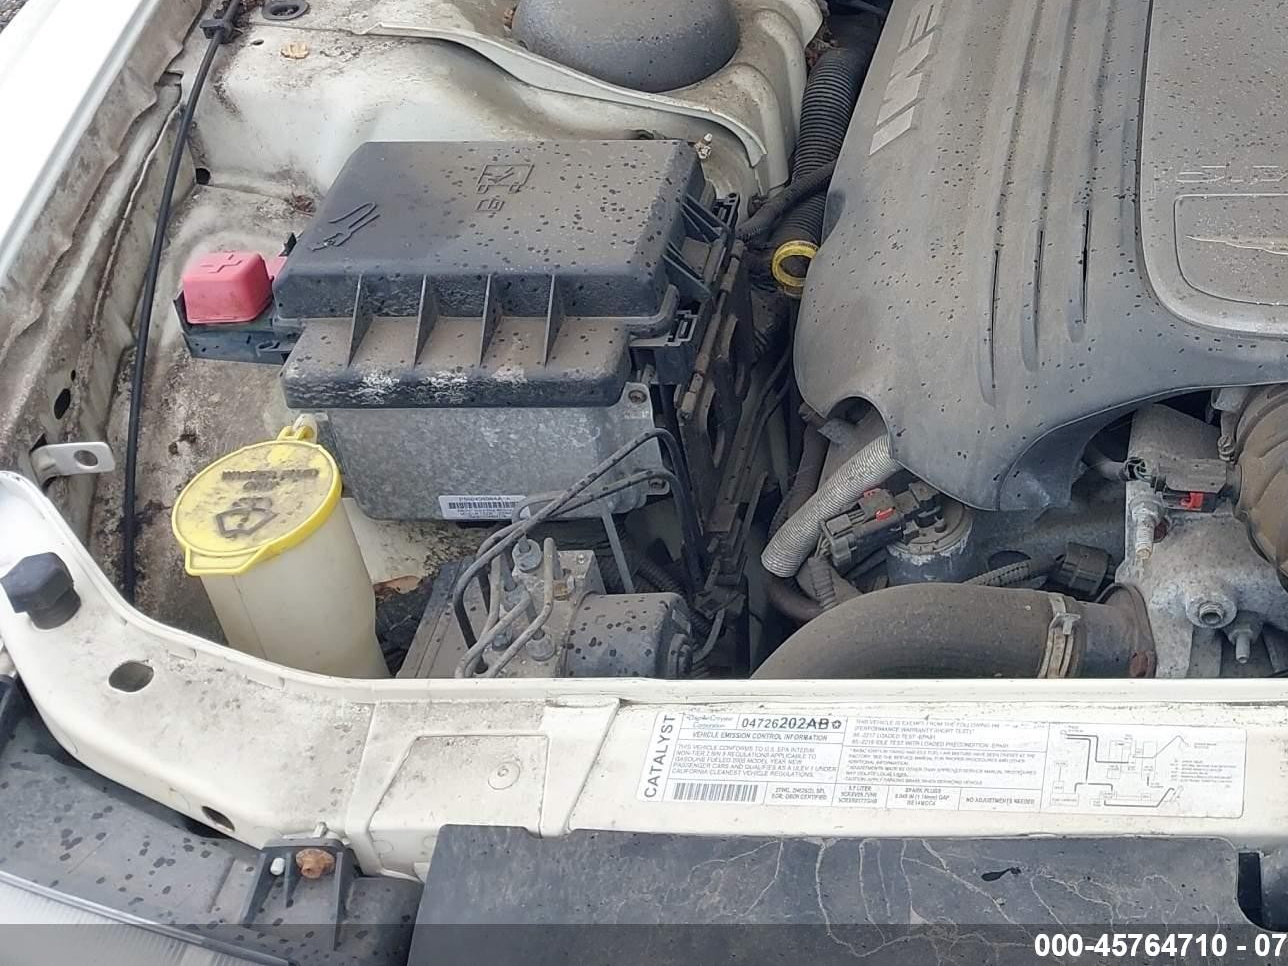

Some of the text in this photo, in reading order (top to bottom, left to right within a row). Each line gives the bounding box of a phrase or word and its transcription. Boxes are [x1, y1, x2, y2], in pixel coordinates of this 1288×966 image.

[741, 717, 829, 729] 04726202AB
[783, 733, 828, 741] INFORMATION
[644, 714, 676, 798] CATALYST
